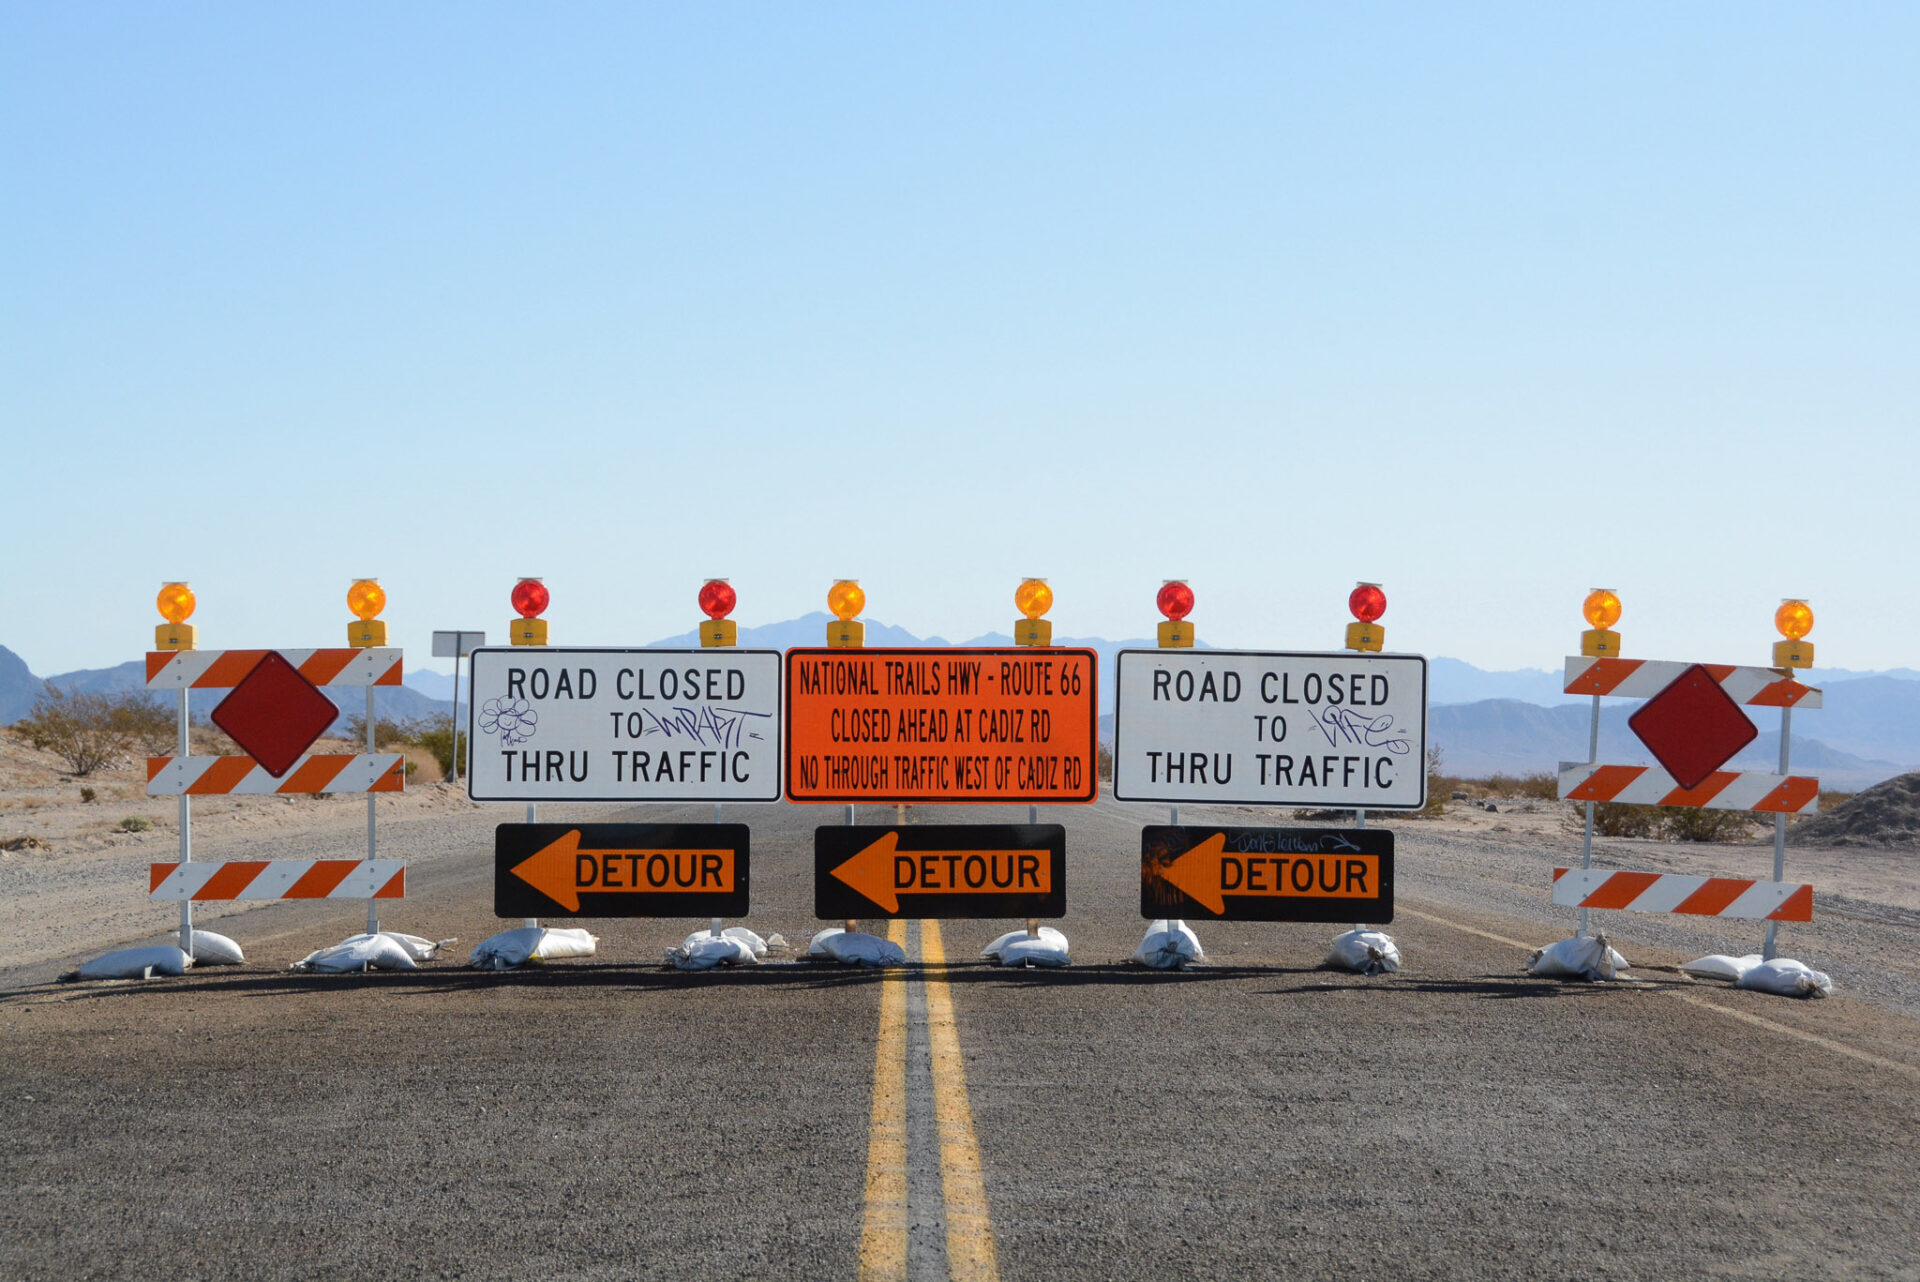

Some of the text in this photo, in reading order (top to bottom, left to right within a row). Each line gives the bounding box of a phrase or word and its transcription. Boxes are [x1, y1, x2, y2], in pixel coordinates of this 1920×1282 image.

[508, 668, 745, 700] ROAD CLOSED
[800, 661, 879, 695] NATIONAL
[885, 661, 940, 695] TRAILS
[948, 662, 981, 695] HWY
[1001, 661, 1053, 695] ROUTE
[1060, 662, 1081, 695] 66
[1153, 669, 1389, 706] ROAD CLOSED
[610, 712, 643, 738] TO
[831, 708, 1050, 742] CLOSED AHEAD AT CADIZ RD
[1254, 715, 1287, 742] TO
[501, 750, 750, 783] THRU TRAFFIC
[800, 755, 1082, 789] NO THROUGH TRAFFIC WEST OF CADIZ RD
[1146, 751, 1393, 789] THRU TRAFFIC
[576, 854, 723, 887] DETOUR
[894, 855, 1040, 888] DETOUR
[1220, 857, 1368, 893] DETOUR
